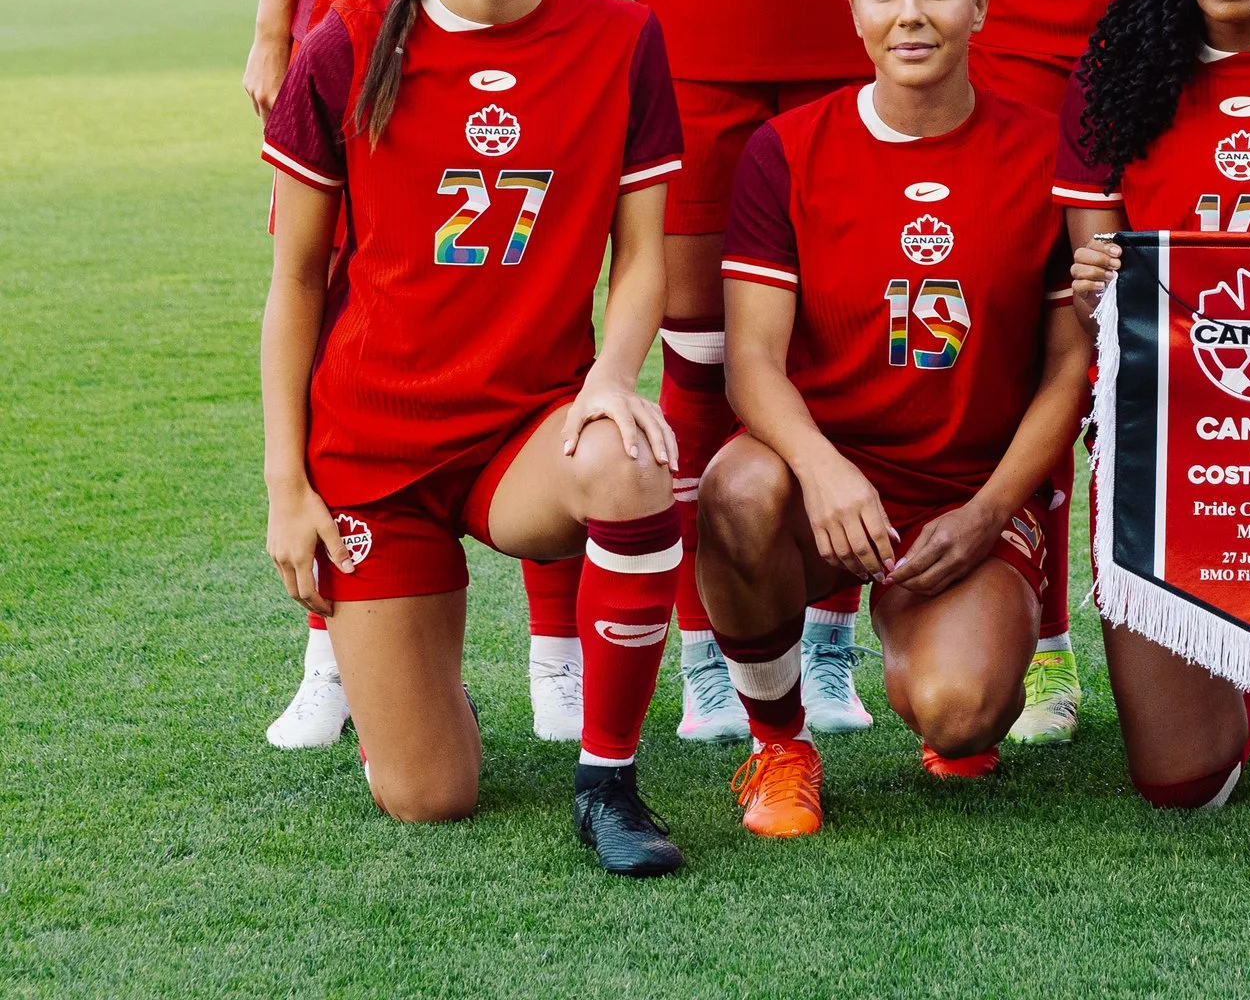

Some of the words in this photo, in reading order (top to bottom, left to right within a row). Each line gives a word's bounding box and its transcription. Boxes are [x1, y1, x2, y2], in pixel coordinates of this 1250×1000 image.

[468, 127, 518, 136] CANADA
[434, 168, 554, 266] 27
[903, 236, 951, 245] CANADA
[883, 279, 972, 370] 19
[1193, 501, 1236, 517] Pride
[1221, 551, 1237, 564] 27
[1199, 568, 1234, 581] BMO
